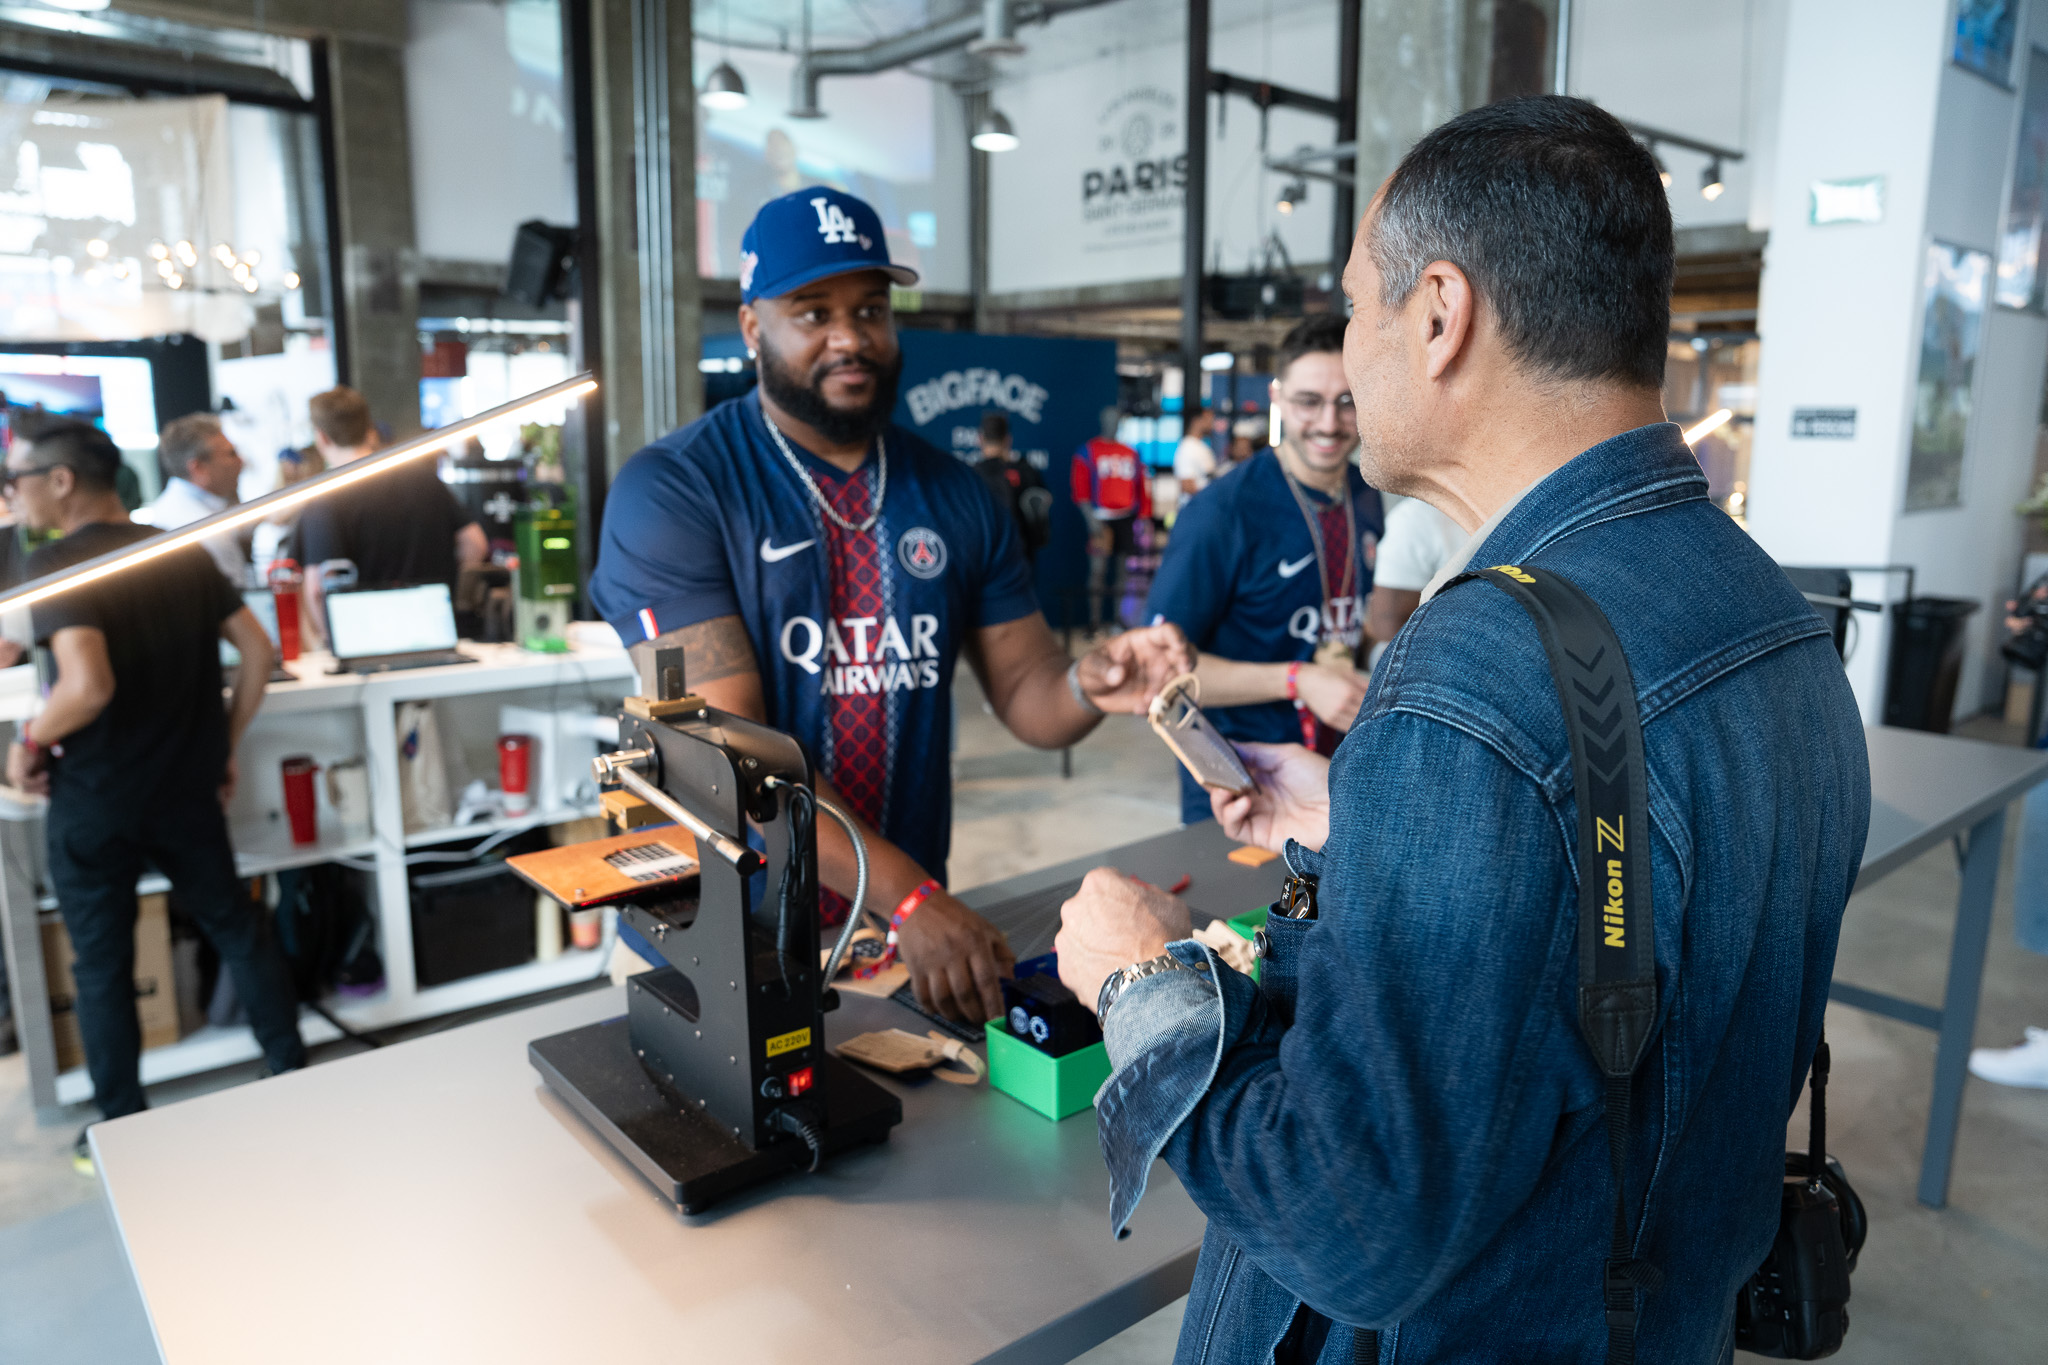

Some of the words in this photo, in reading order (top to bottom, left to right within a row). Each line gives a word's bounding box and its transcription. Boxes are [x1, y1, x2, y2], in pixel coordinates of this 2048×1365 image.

[1083, 154, 1188, 201] PARIS
[810, 197, 857, 243] LA
[905, 367, 1048, 426] BIGFACE
[780, 614, 939, 674] QATAR
[820, 659, 939, 695] AIRWAYS
[1596, 815, 1624, 853] Z
[1603, 859, 1625, 948] Nikon
[770, 1040, 783, 1051] AC
[784, 1032, 809, 1048] 220V
